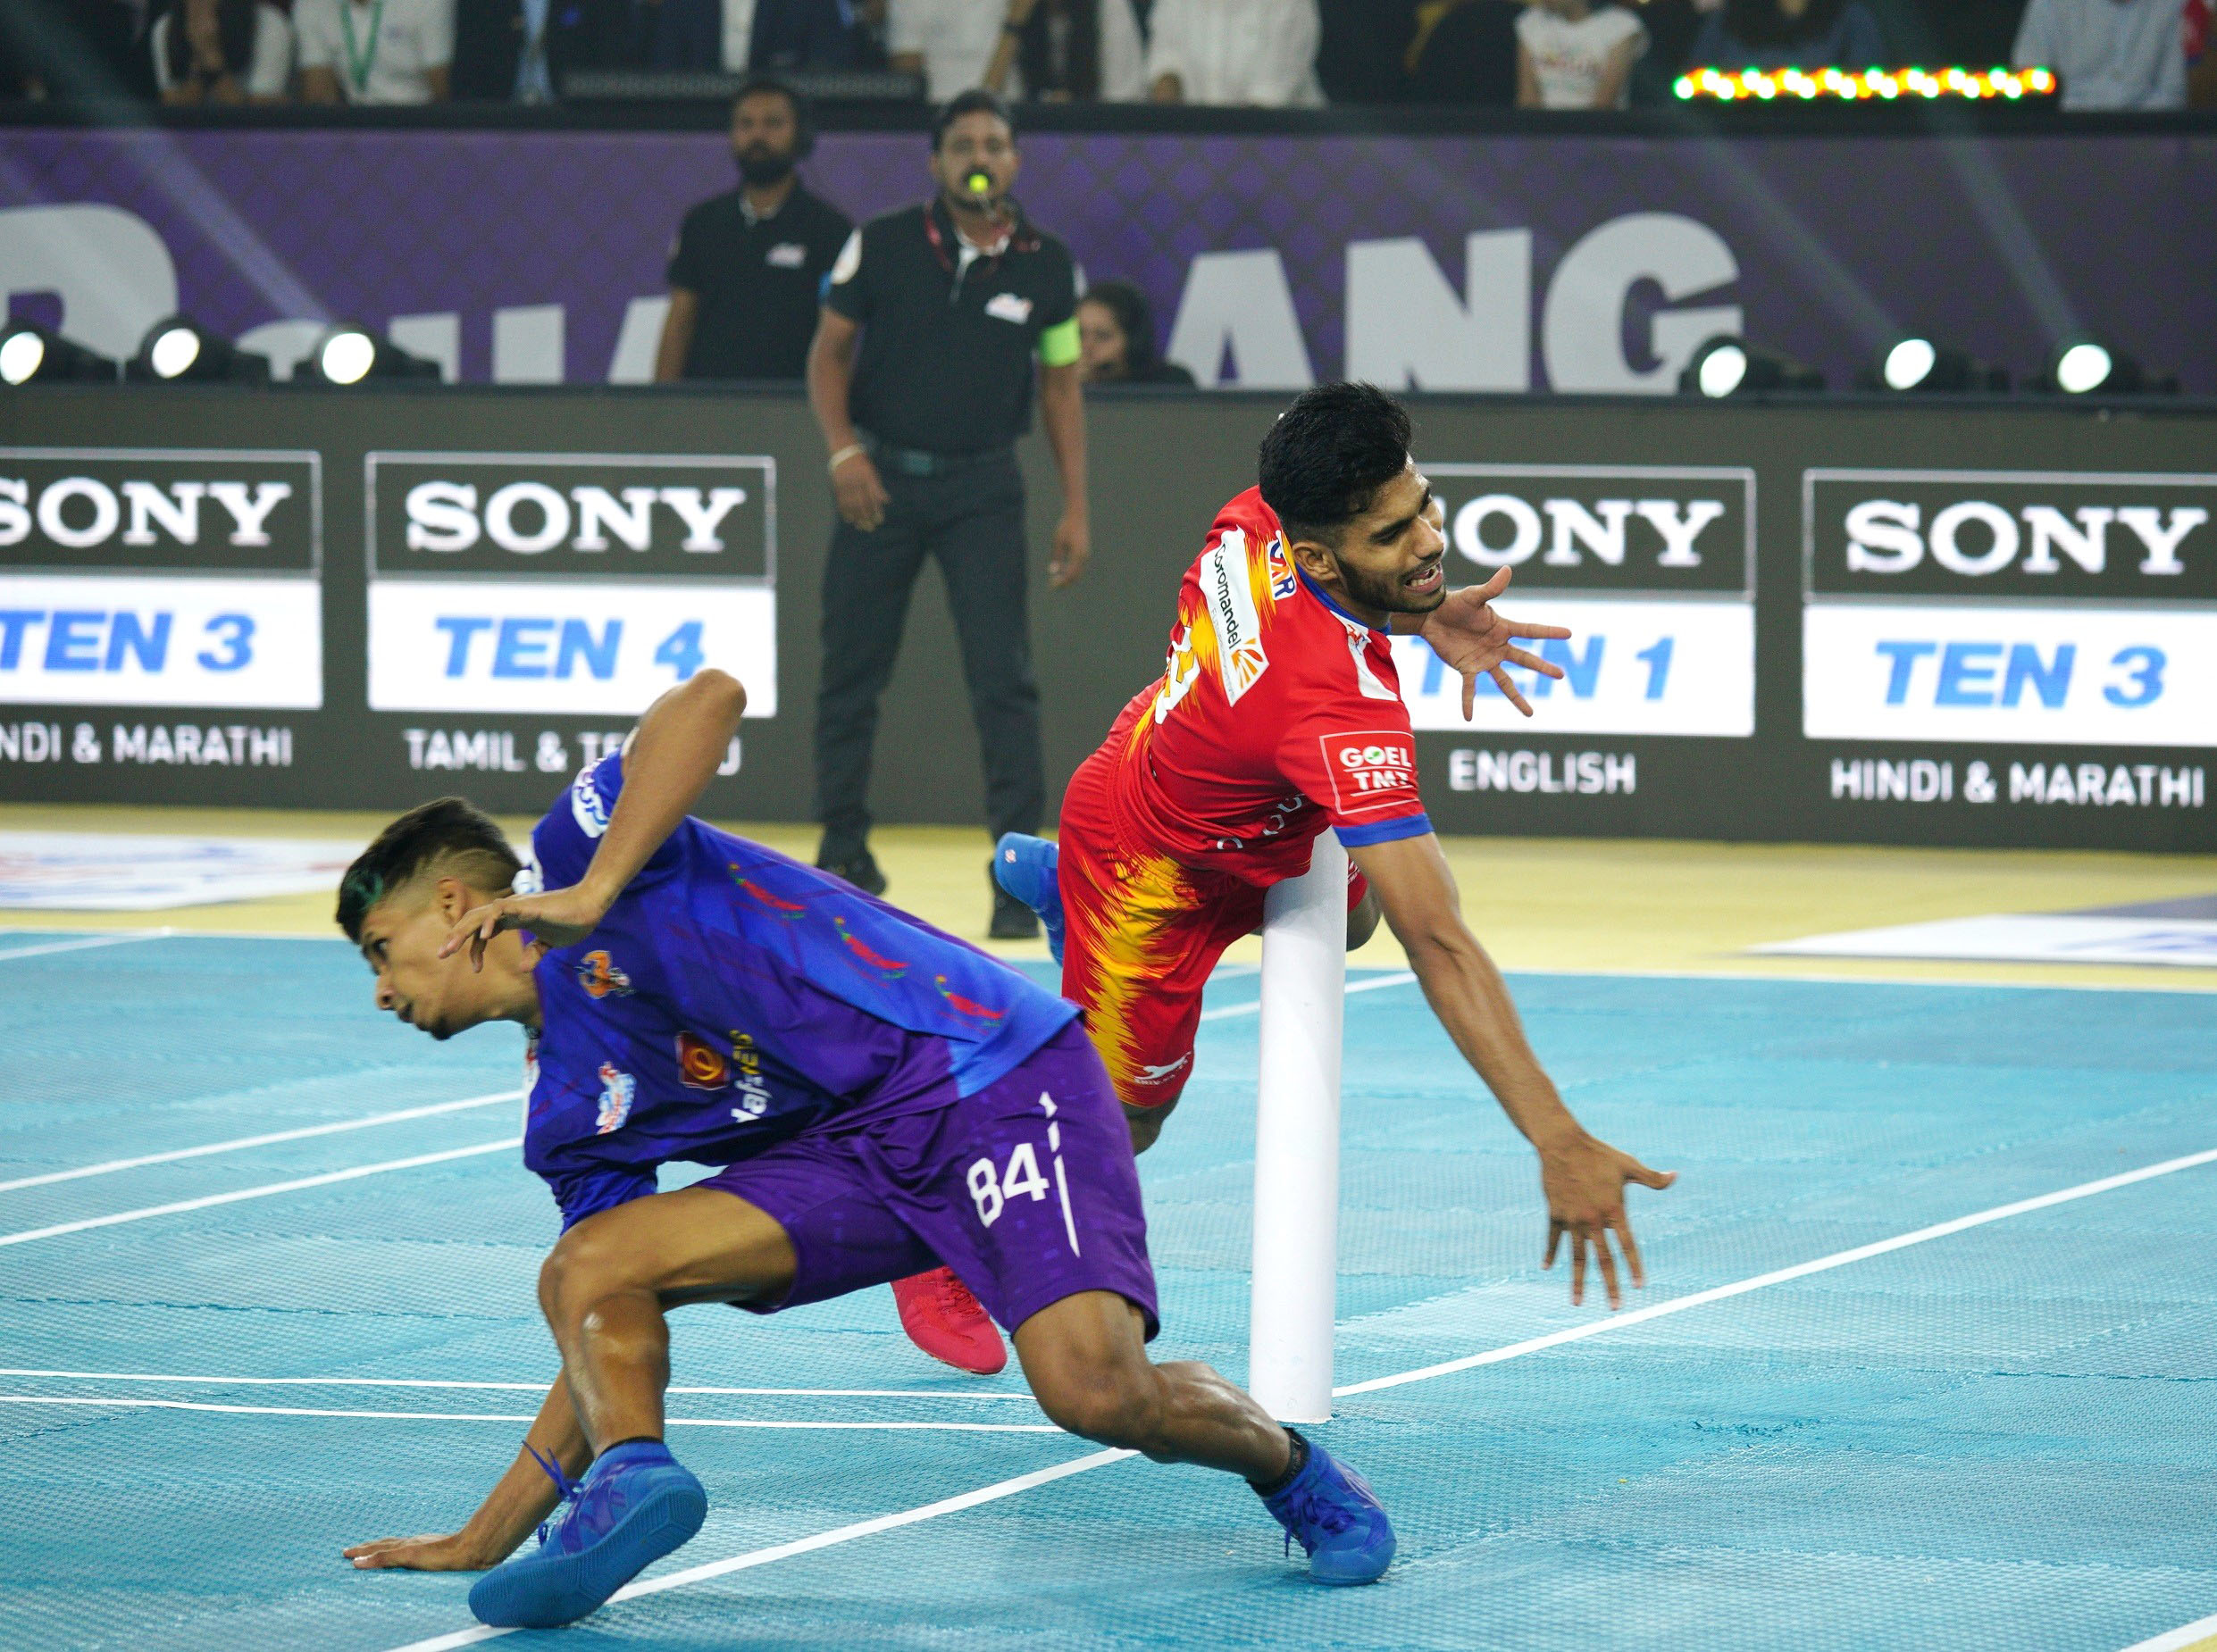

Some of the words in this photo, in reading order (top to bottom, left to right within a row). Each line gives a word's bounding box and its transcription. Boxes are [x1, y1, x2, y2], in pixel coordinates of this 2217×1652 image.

[406, 480, 747, 555] SONY
[1439, 494, 1725, 567] ONY
[1845, 498, 2209, 576] SONY
[0, 610, 173, 672] TEN
[196, 613, 257, 672] 3
[435, 615, 623, 680] TEN
[654, 620, 706, 680] 4
[1636, 636, 1674, 700] 1
[1875, 641, 2077, 709] TEN
[2103, 645, 2168, 709] 3
[72, 722, 102, 763] &
[113, 723, 293, 766] MARATHI
[403, 728, 526, 772] TAMIL
[536, 730, 568, 772] &
[1339, 745, 1413, 768] GOEL
[1448, 748, 1636, 794] ENGLISH
[1829, 757, 1953, 802] HINDI
[1963, 760, 1997, 804] &
[2009, 762, 2205, 807] MARATHI
[966, 1142, 1050, 1229] 84
